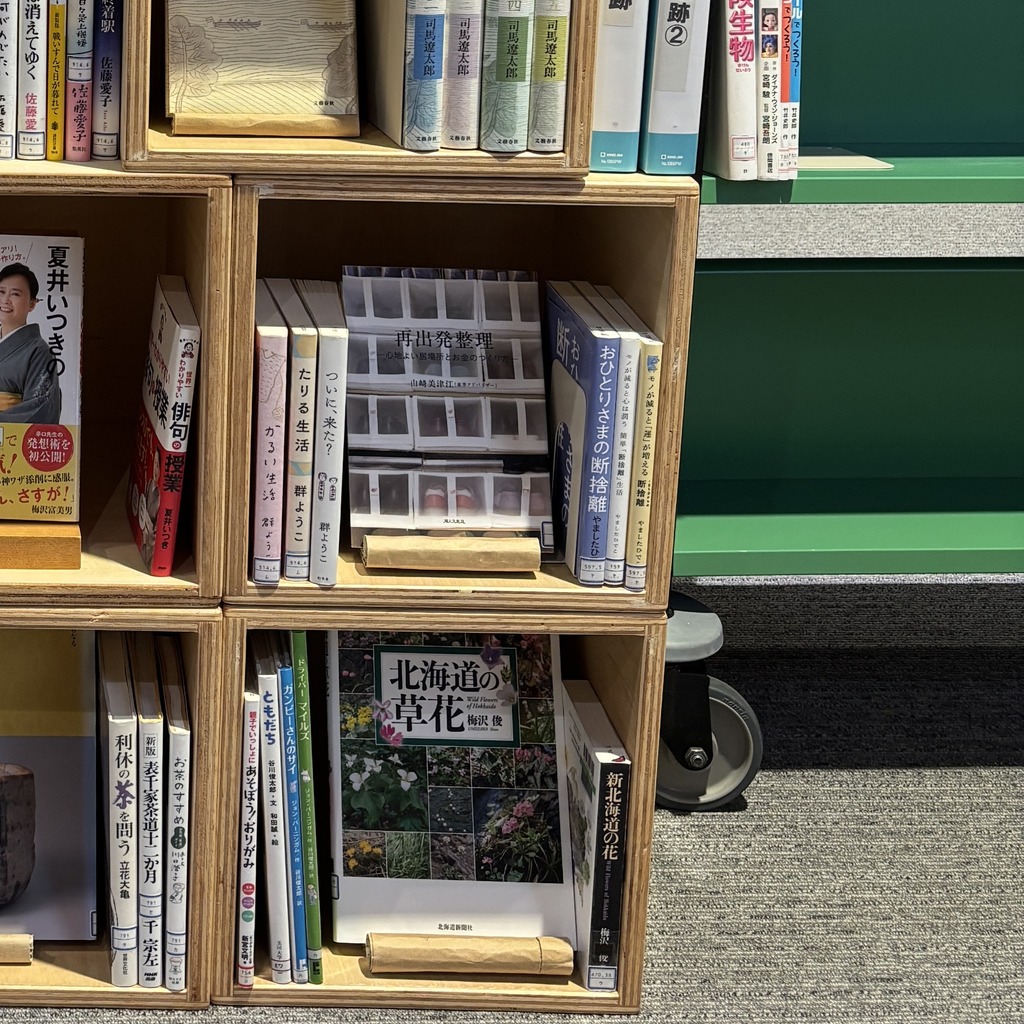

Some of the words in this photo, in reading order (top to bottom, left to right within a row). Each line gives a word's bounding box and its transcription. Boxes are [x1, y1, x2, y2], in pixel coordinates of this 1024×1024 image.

[423, 17, 437, 77] 司馬遼太郎
[457, 17, 471, 76] 司馬遼太郎
[506, 19, 519, 79] 司馬遼太郎
[544, 18, 558, 78] 司馬遼太郎
[51, 32, 61, 116] 戦いすんで日が暮れて
[99, 56, 113, 108] 佐藤愛子
[72, 84, 88, 143] 佐藤愛子
[46, 245, 70, 376] 夏井いつきの
[394, 329, 494, 350] 再出発整理
[175, 359, 186, 398] わかりやすい
[294, 367, 311, 453] たりる生活
[588, 345, 616, 513] おひとりさまの断捨離
[27, 438, 71, 451] 発想術を
[31, 505, 73, 515] 梅沢富美男
[293, 485, 307, 542] 群ようこ
[636, 479, 647, 507] 断捨離
[161, 508, 173, 549] 夏井いつき
[318, 521, 331, 563] 群ようこ
[590, 515, 602, 558] やましたひ
[297, 658, 307, 697] ドライバー
[390, 659, 500, 693] 北海道の
[248, 711, 258, 764] 親子でいっしょに
[262, 690, 276, 746] ともだち
[283, 684, 297, 775] ガンピーさんのサイ
[298, 702, 310, 741] マイルズ
[391, 694, 465, 733] 草花
[144, 735, 157, 756] 新版
[112, 733, 136, 857] 利休の茶を問う
[172, 756, 187, 825] お茶のすすめ
[602, 772, 624, 861] 新北海道の花
[142, 760, 159, 884] 表千家茶道十二か月
[119, 860, 131, 899] 立花大亀
[437, 923, 473, 931] 北海道新聞社
